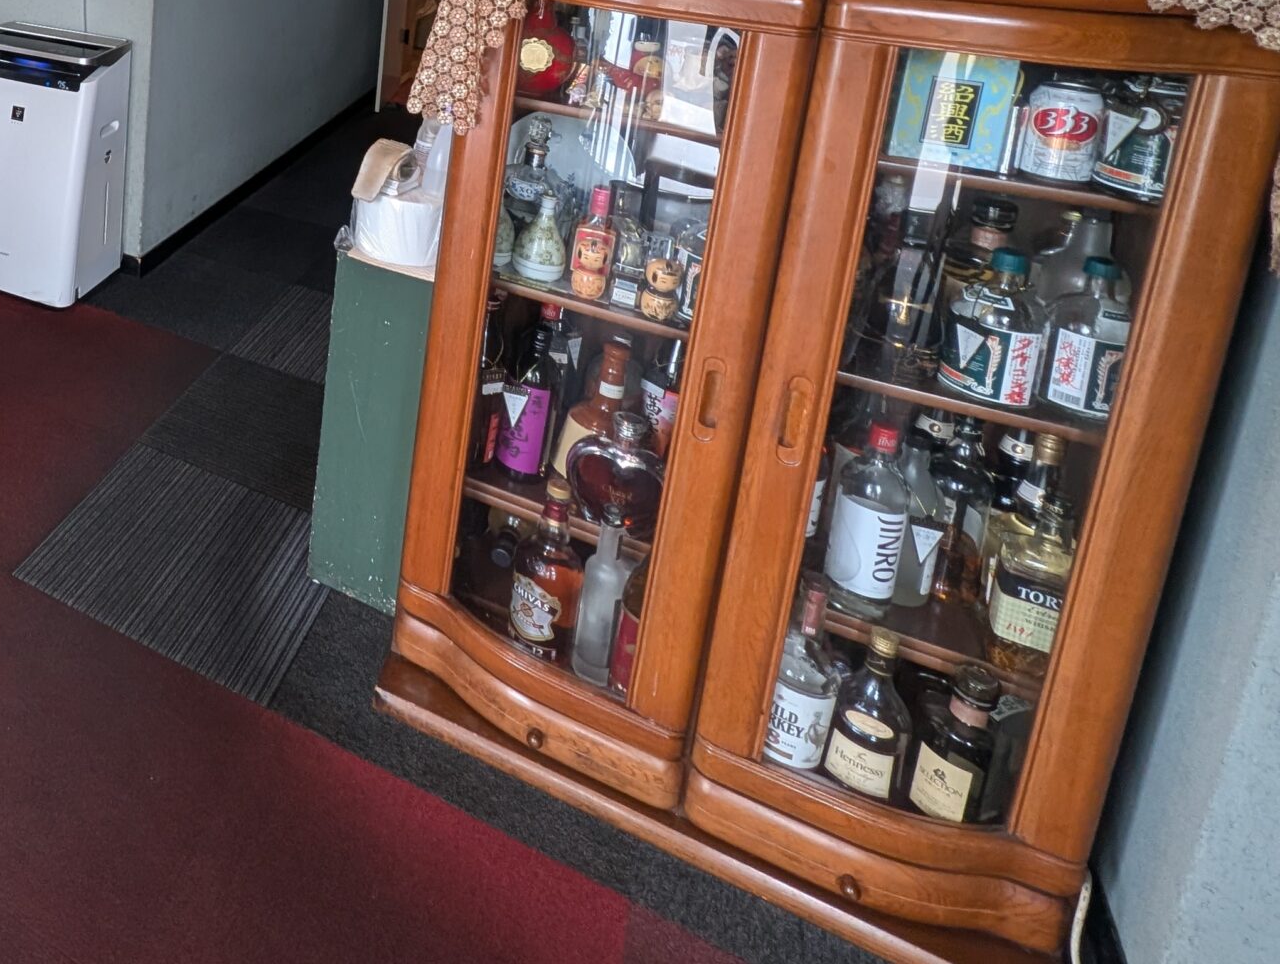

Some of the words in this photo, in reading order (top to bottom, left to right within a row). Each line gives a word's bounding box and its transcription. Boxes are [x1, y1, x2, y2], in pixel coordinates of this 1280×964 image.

[929, 81, 976, 144] 紹興酒
[1038, 105, 1090, 136] 333
[872, 516, 904, 584] JINRO
[513, 582, 550, 613] CHIVAS
[834, 745, 886, 780] Hennessy
